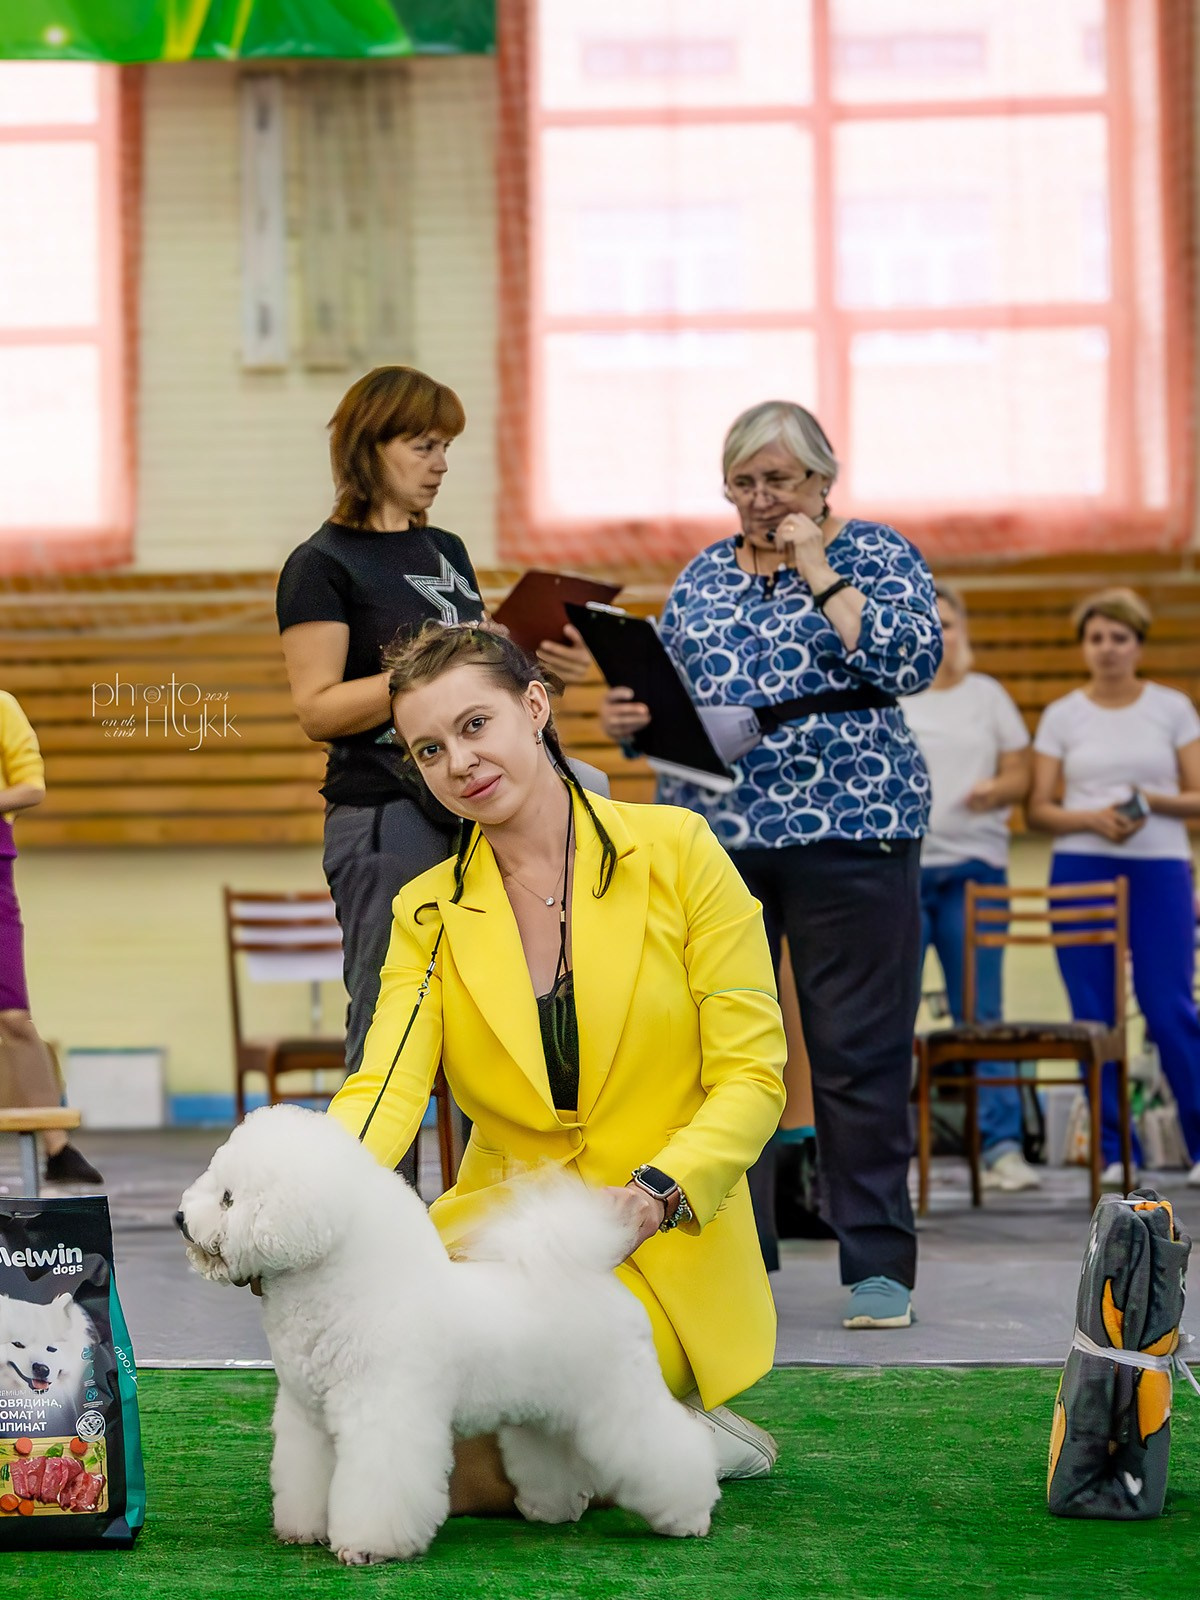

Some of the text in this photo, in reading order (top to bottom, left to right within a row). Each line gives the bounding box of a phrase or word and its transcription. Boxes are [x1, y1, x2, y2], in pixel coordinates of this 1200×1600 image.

[52, 1263, 83, 1276] dogs
[113, 1346, 134, 1374] FOOD
[36, 1409, 46, 1419] И
